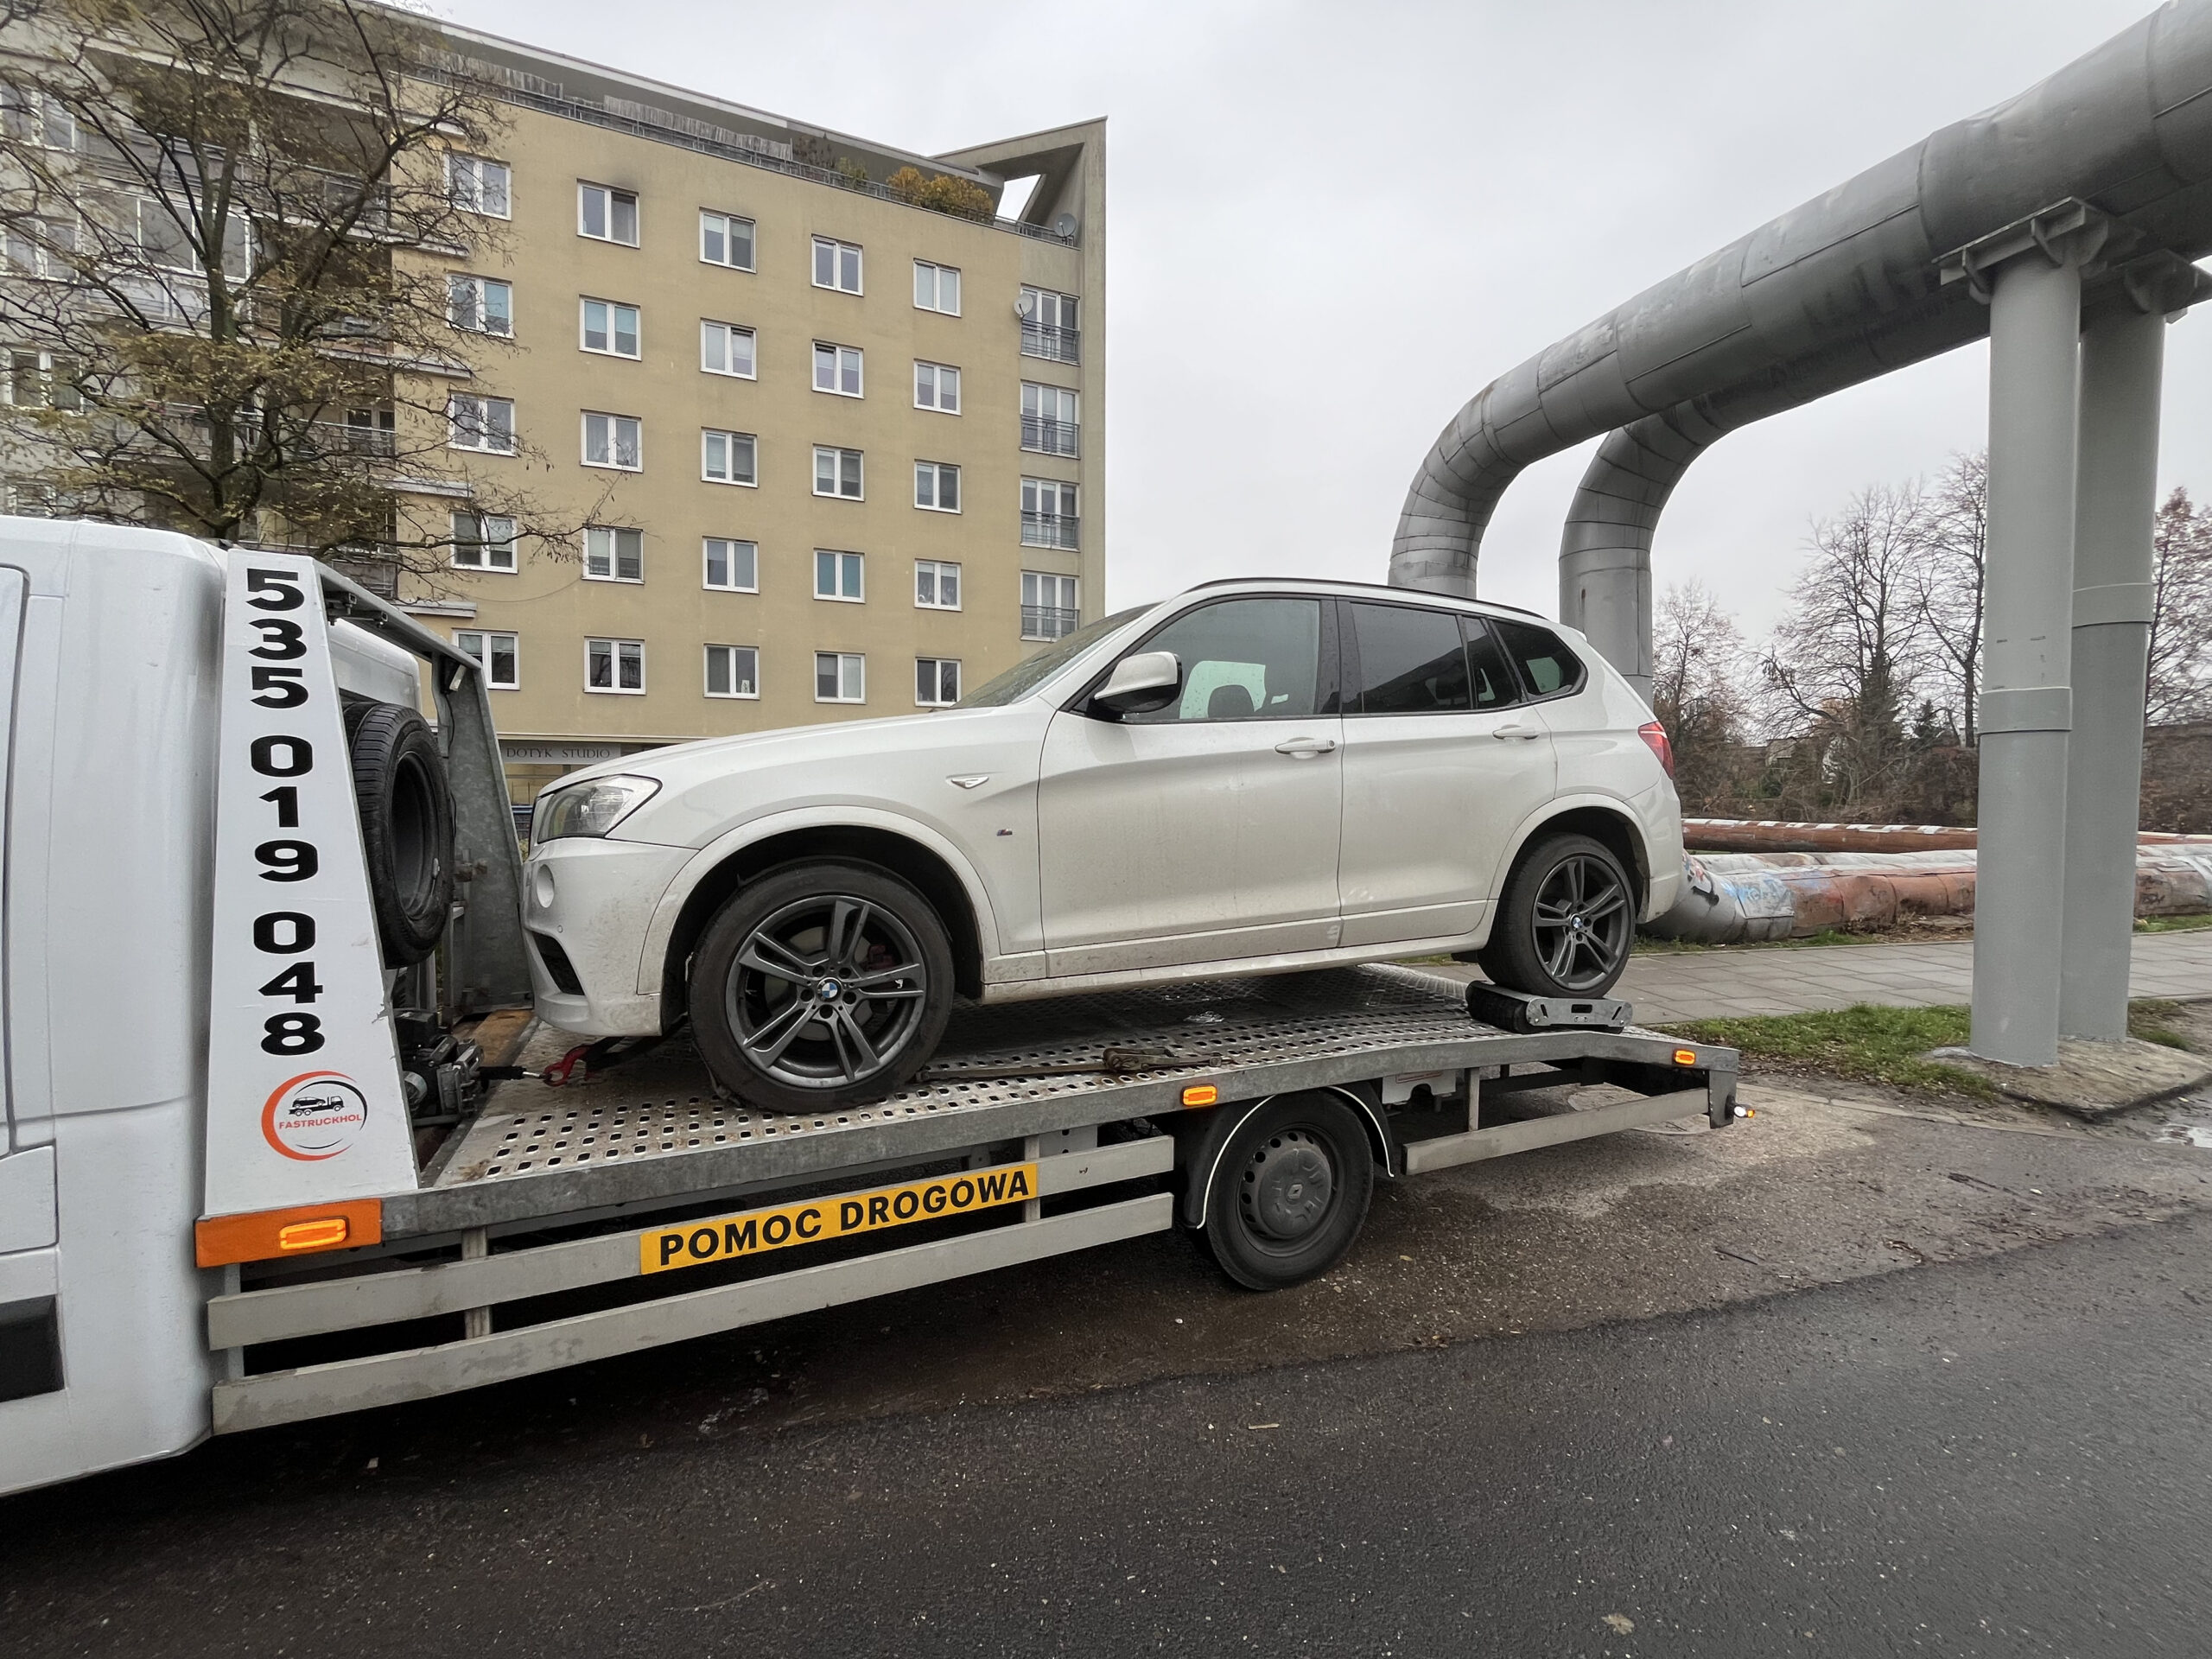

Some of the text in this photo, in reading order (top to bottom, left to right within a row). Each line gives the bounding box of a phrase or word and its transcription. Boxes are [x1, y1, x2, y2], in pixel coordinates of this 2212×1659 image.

[506, 747, 610, 759] DOTYK STUDIO
[245, 568, 326, 1056] 535 019 048
[278, 1114, 362, 1129] FASTRUCKHOL
[659, 1169, 1029, 1266] POMOC DROGOWA
